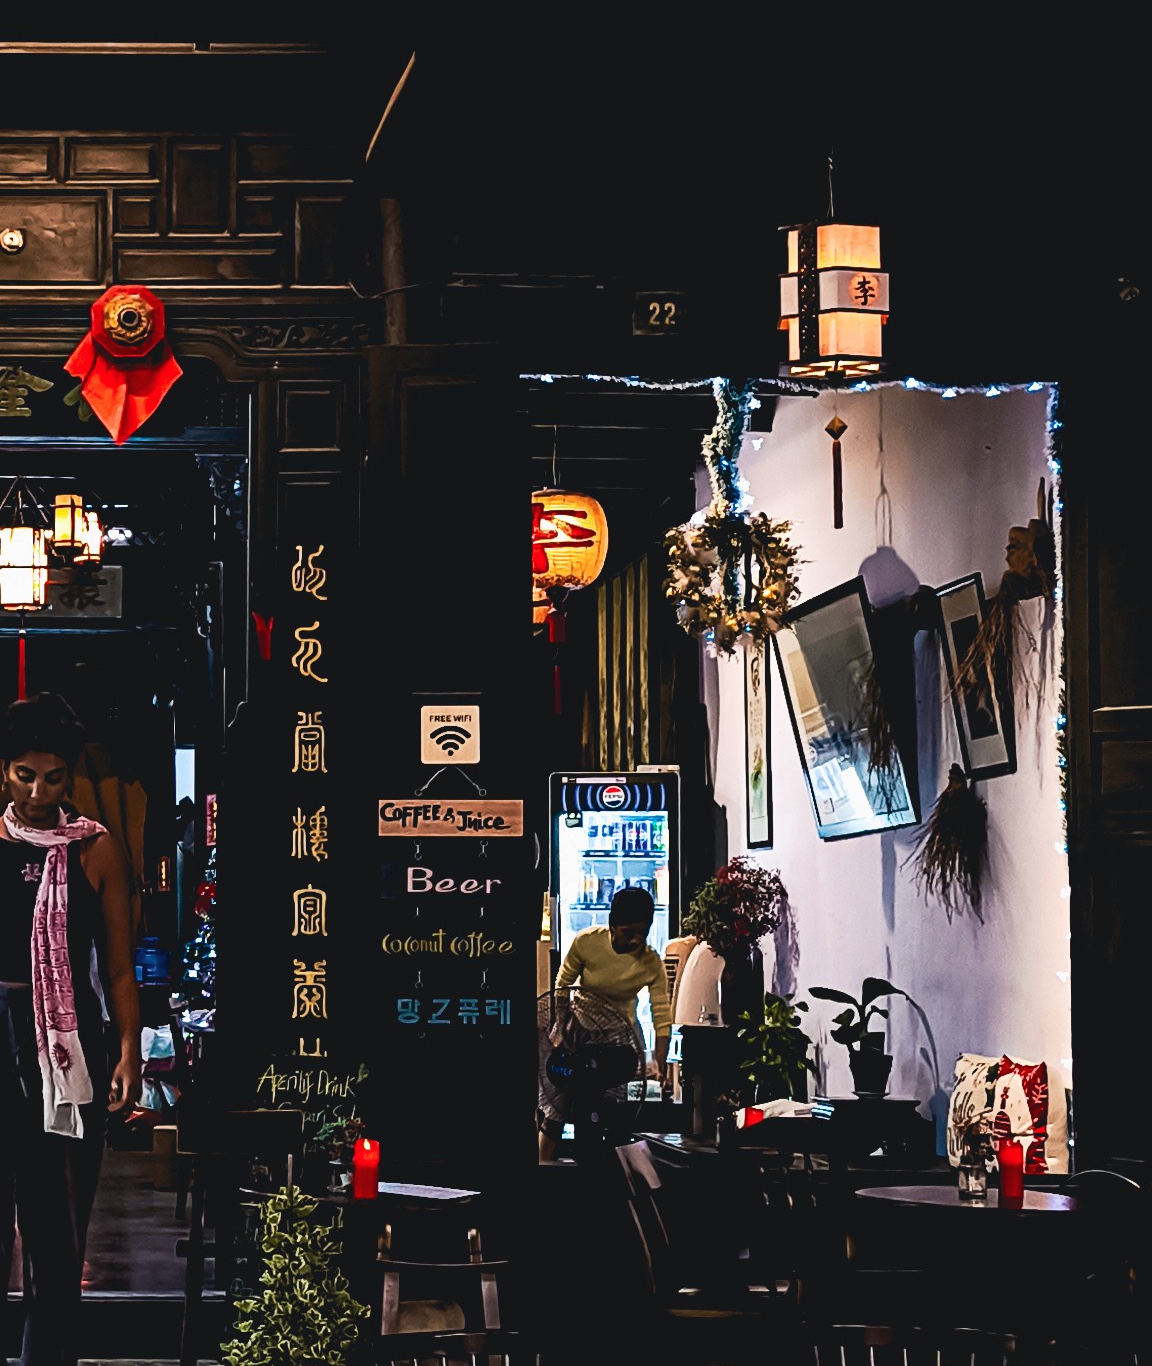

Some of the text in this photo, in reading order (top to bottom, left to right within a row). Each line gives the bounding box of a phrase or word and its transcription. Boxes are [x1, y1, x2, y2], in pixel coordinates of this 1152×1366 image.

[854, 276, 876, 306] 李
[649, 301, 676, 325] 22
[429, 714, 452, 723] FREE
[407, 866, 502, 894] Beer
